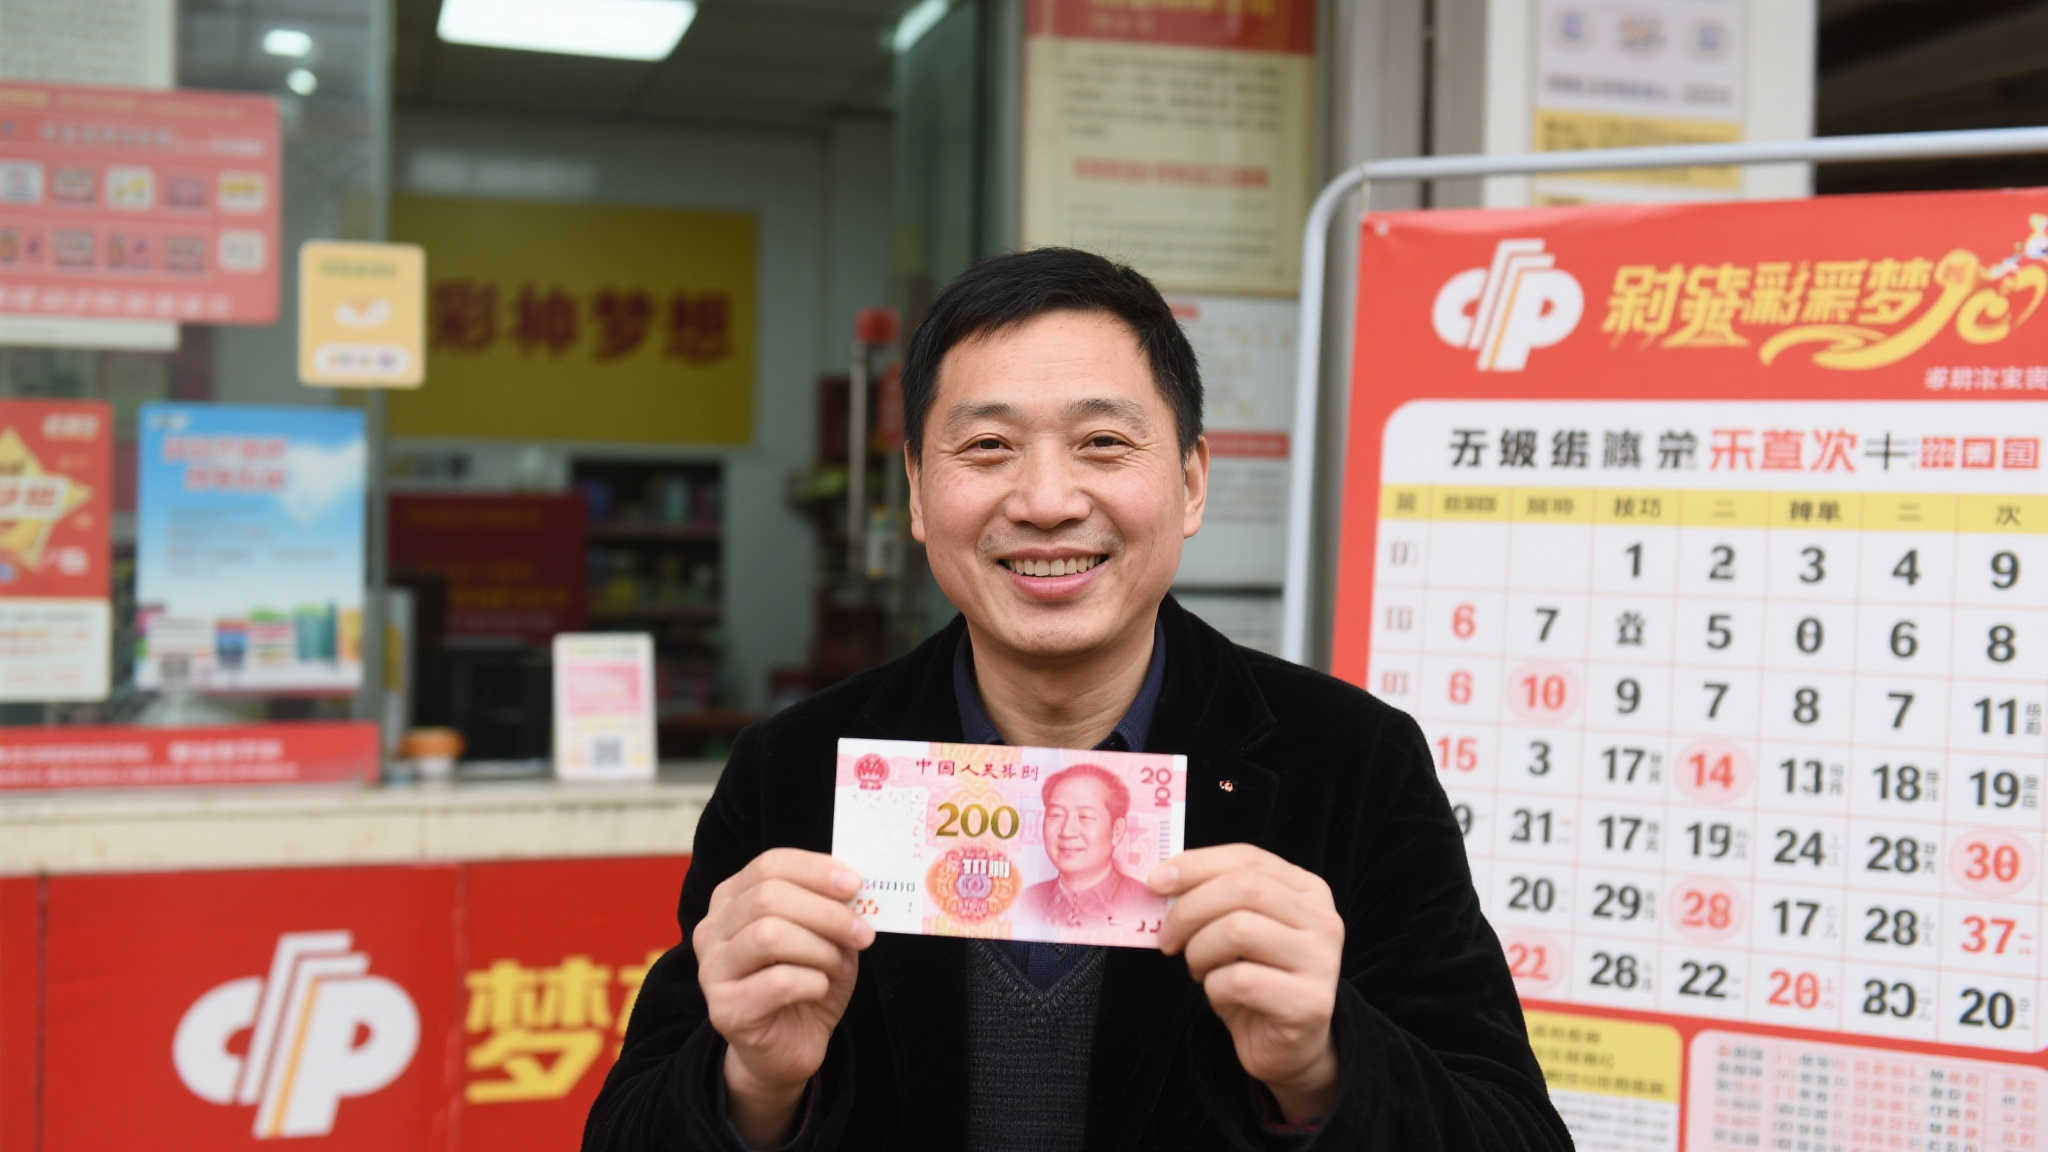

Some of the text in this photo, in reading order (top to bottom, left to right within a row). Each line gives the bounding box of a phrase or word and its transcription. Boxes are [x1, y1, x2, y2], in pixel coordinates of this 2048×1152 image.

[1626, 543, 2021, 590] 1 2 3 4 9
[1451, 603, 1476, 639] 6
[1535, 607, 1559, 643] 7
[1706, 614, 1733, 651] 5
[1889, 620, 1919, 659] 6
[1986, 624, 2017, 664] 8
[1523, 674, 1566, 710] 10
[1615, 678, 1642, 715] 9
[1703, 682, 1729, 719] 7
[1792, 687, 1820, 725] 8
[1887, 692, 1915, 729] 7
[1974, 697, 2017, 736] 11
[1437, 736, 1478, 773] 15
[1528, 741, 1551, 777] 3
[1603, 747, 1646, 783] 17
[1689, 753, 1734, 789] 14
[1873, 764, 1922, 803] 18
[1969, 770, 2021, 809] 19
[936, 803, 1020, 840] 200
[1599, 815, 1643, 851] 17
[1773, 828, 1826, 867] 24
[1866, 835, 1921, 874] 28
[1965, 842, 2021, 883] 30
[1507, 875, 2017, 955] 20 29 28 17 28 37
[1589, 951, 1639, 990] 28
[1678, 961, 1728, 999] 22
[465, 950, 672, 1103] 梦
